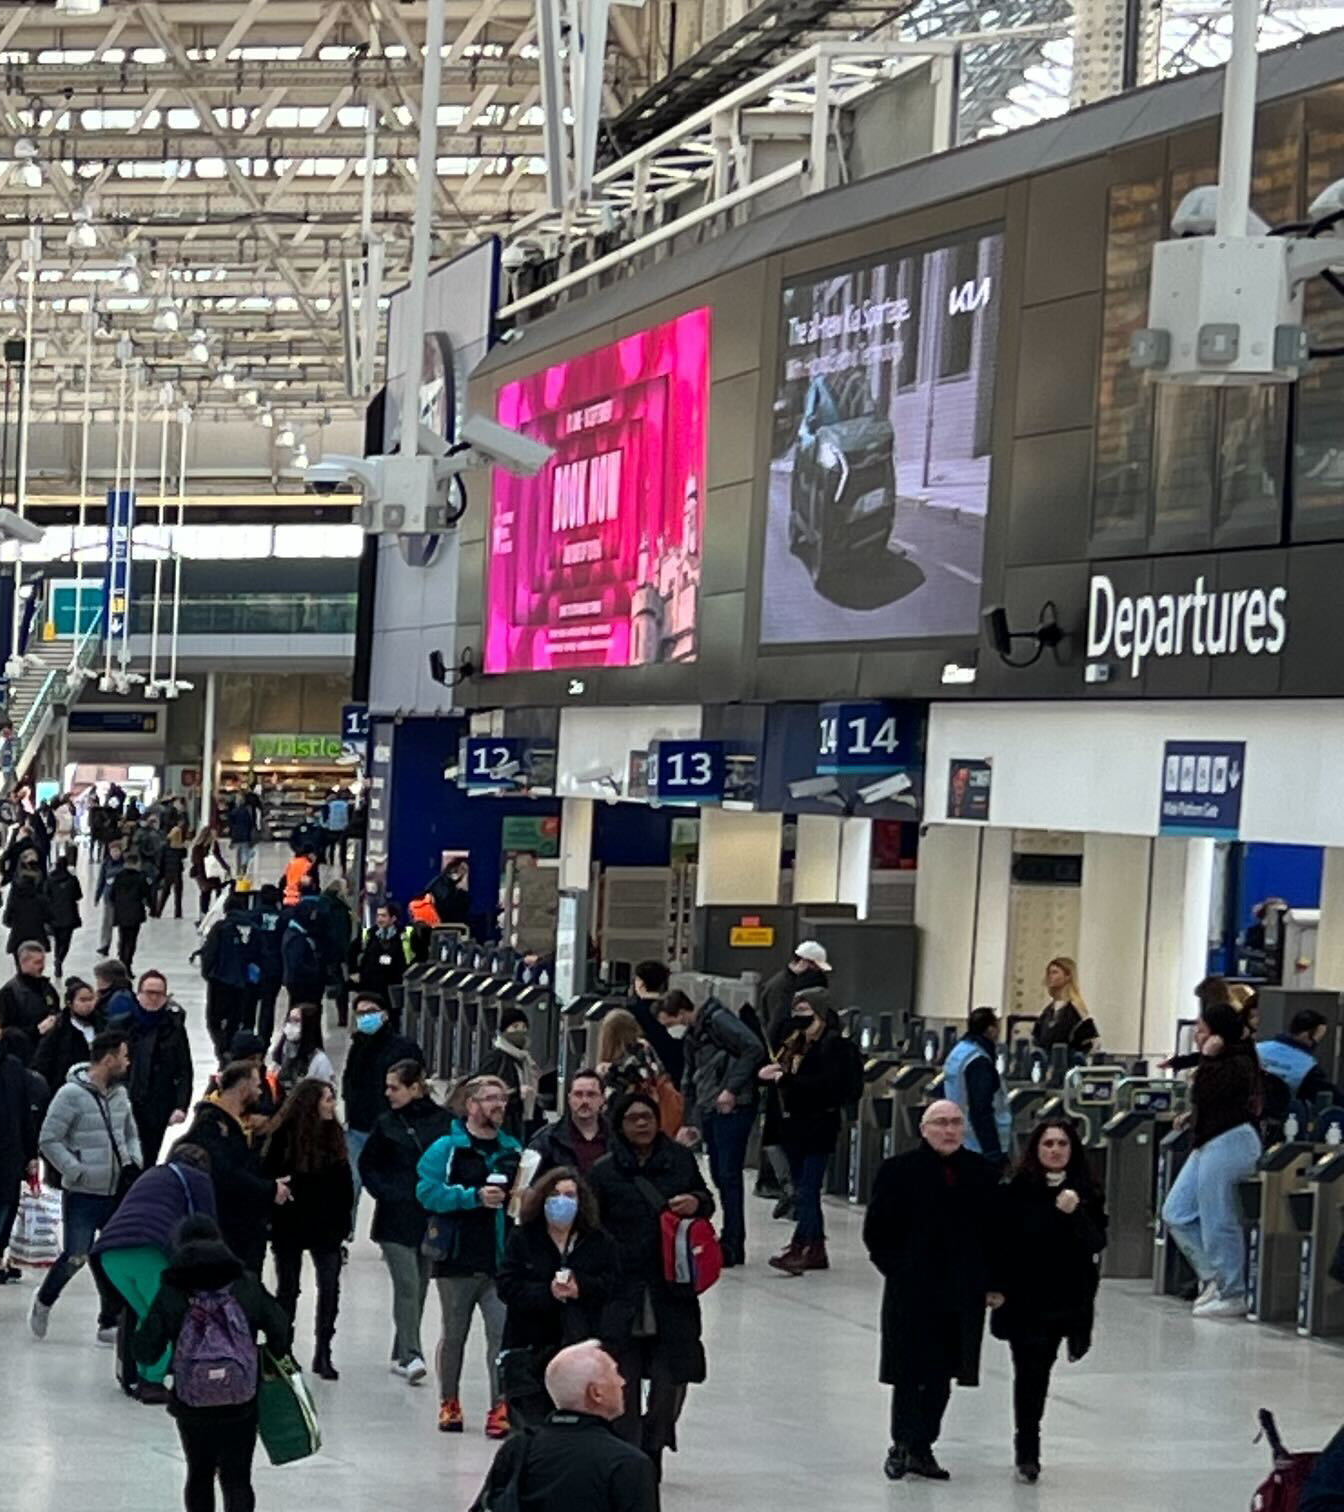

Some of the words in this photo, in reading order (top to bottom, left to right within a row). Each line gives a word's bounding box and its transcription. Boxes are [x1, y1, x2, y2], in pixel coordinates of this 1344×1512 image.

[1087, 574, 1288, 679] Departures
[847, 716, 900, 755] 14
[472, 747, 511, 775] 12
[666, 752, 712, 786] 13
